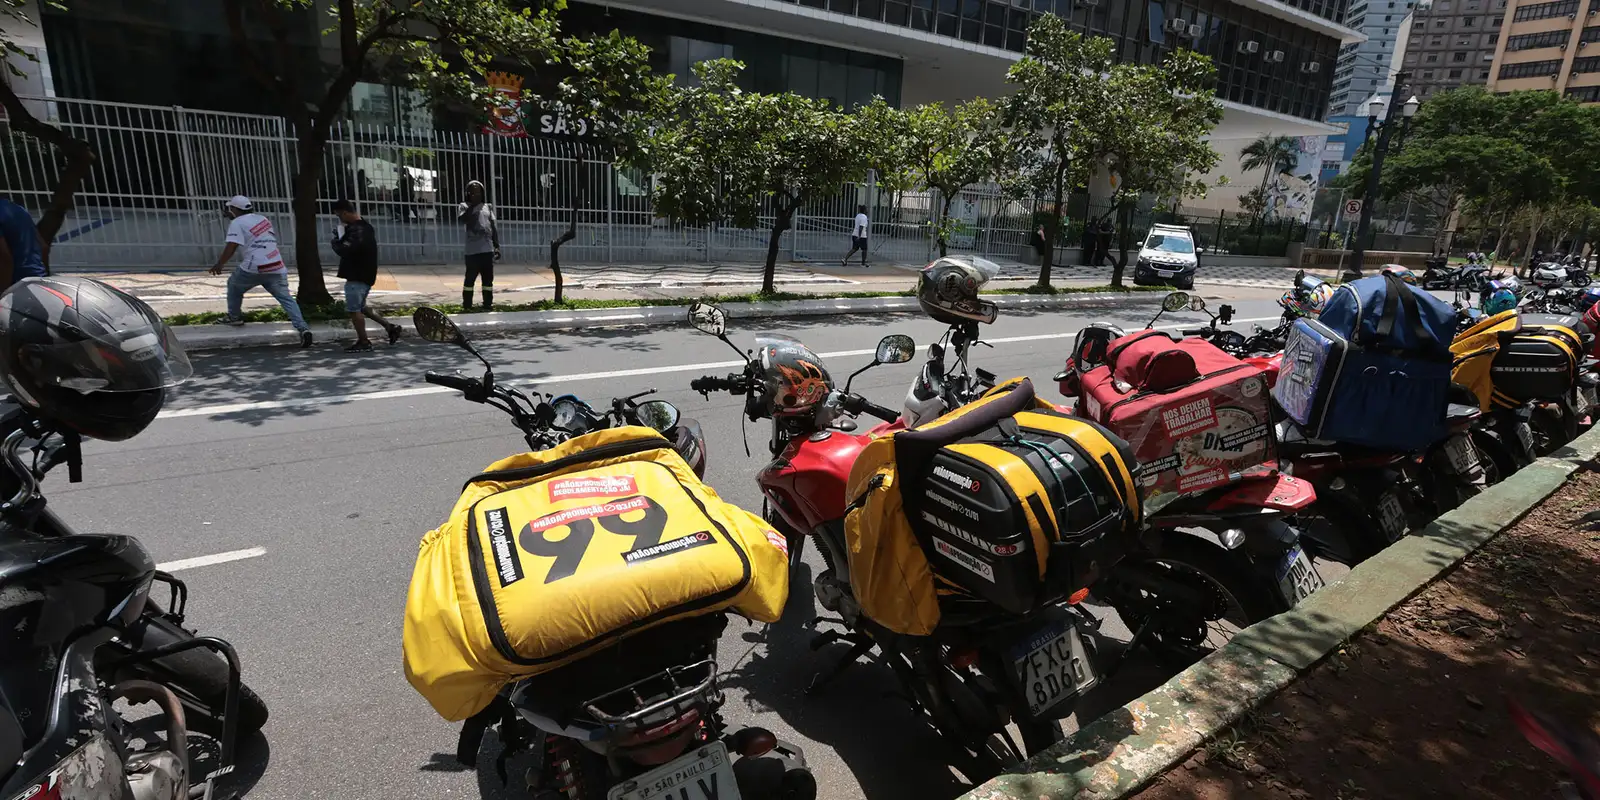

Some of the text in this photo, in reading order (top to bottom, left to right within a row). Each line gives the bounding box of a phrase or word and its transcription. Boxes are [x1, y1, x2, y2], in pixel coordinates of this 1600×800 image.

[540, 112, 588, 136] SÃO
[1163, 397, 1210, 421] NOS DEIXEM
[1165, 406, 1212, 430] TRABALHAR
[533, 500, 644, 529] #NÃOAPROIBIÇÃO 03/02
[519, 495, 668, 584] 99
[936, 518, 994, 553] UTILITY
[627, 535, 698, 562] #NÃOAPROIBIÇÃO
[1031, 632, 1058, 649] BRASIL
[1030, 636, 1071, 678] FXC
[676, 762, 706, 782] PAULO
